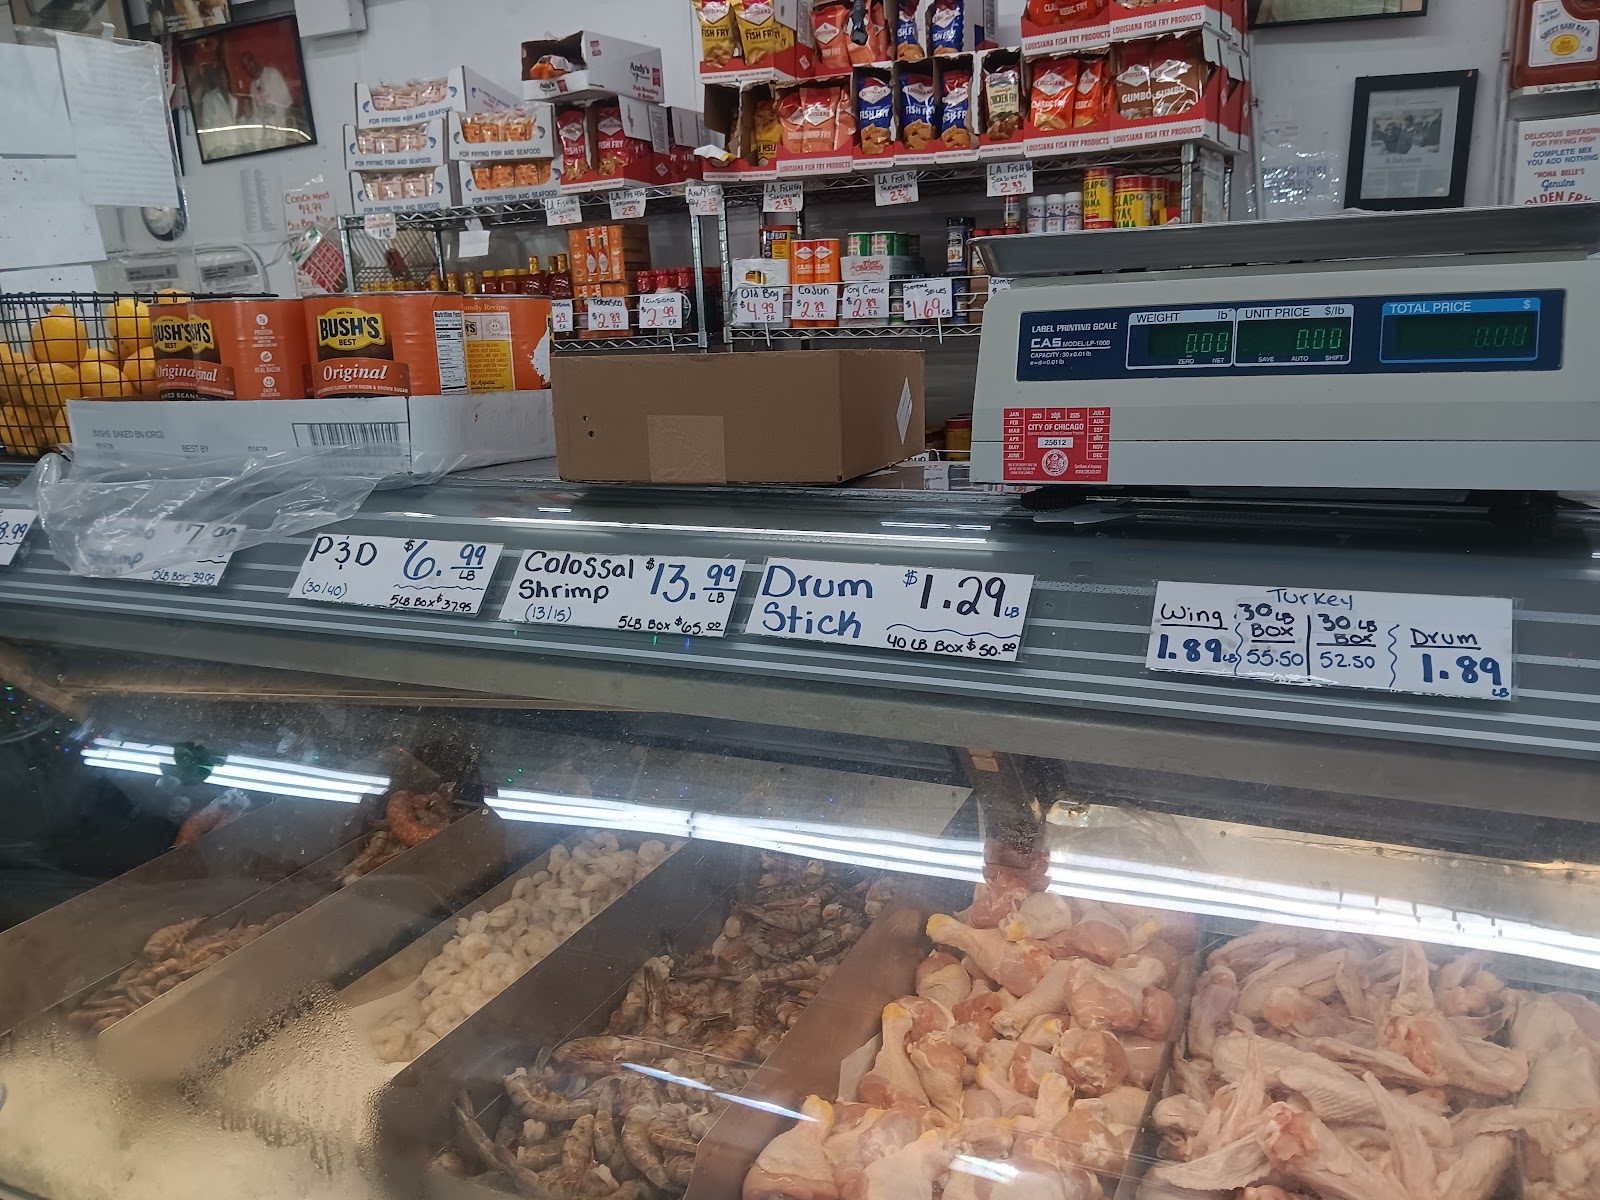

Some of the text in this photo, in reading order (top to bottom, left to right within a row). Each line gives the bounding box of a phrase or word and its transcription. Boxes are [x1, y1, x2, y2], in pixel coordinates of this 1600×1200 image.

[1112, 12, 1202, 34] LOUISIANA FISH FRY PRODUCTS
[702, 28, 730, 37] FISH FRY
[745, 31, 761, 40] FISH
[1024, 29, 1110, 50] LOUISIANA FISH FRY PRODUCTS
[1121, 91, 1152, 104] GUMBO
[1155, 86, 1186, 100] GUMBO
[905, 106, 921, 115] FISH
[1113, 125, 1202, 142] LOUISIANA FISH FRY PRODUCTS
[1524, 130, 1563, 140] DELICIOUS
[598, 140, 624, 149] FISH FRY
[1026, 137, 1110, 152] LOUISIANA FISH FRY PRODUCTS
[1548, 137, 1577, 146] FRYING
[1533, 146, 1593, 158] COMPLETE MIX
[825, 161, 851, 169] PRODUCTS
[1526, 153, 1599, 167] YOU ADD NOTHING
[1541, 179, 1575, 191] Genuine
[531, 189, 558, 197] SEAFOOD
[740, 288, 779, 301] Old Bay
[1245, 306, 1345, 319] UNIT PRICE $/lb
[1390, 299, 1531, 314] TOTAL PRICE $
[1136, 311, 1228, 323] WEIGHT lb
[320, 315, 382, 341] BUSH'S
[1032, 322, 1118, 333] LABEL PRINTING SCALE
[338, 338, 357, 347] BEST
[1031, 337, 1062, 348] CAS
[1185, 332, 1229, 353] 0.00
[1296, 328, 1342, 350] 0.00
[1474, 325, 1528, 348] 0.00
[323, 363, 388, 382] Original
[1027, 422, 1084, 431] CITY OF CHICAGO
[181, 444, 199, 453] BEST
[524, 550, 634, 580] Colossal
[458, 569, 476, 581] LB
[762, 565, 873, 598] Drum
[301, 577, 348, 600] (30/40)
[518, 579, 610, 604] Shrimp
[902, 568, 1020, 618] $1.29 LB
[389, 595, 410, 607] 5LB
[707, 593, 725, 603] LB
[1266, 588, 1353, 611] Turkey
[524, 603, 572, 623] (13/15)
[762, 602, 863, 639] Stick
[1160, 603, 1223, 629] Wing
[1237, 602, 1295, 625] 30 LB
[618, 615, 642, 630] 5LB
[648, 618, 670, 631] Box
[1317, 613, 1378, 633] 30 LB
[887, 633, 907, 649] 40
[910, 638, 928, 651] LB
[933, 640, 964, 653] Box
[1410, 627, 1478, 646] Drum
[1157, 633, 1238, 664] 1.89 LB
[1246, 648, 1304, 667] 55.50
[1320, 651, 1376, 669] 52.50
[1422, 653, 1502, 686] 1.89
[1491, 687, 1510, 698] LB
